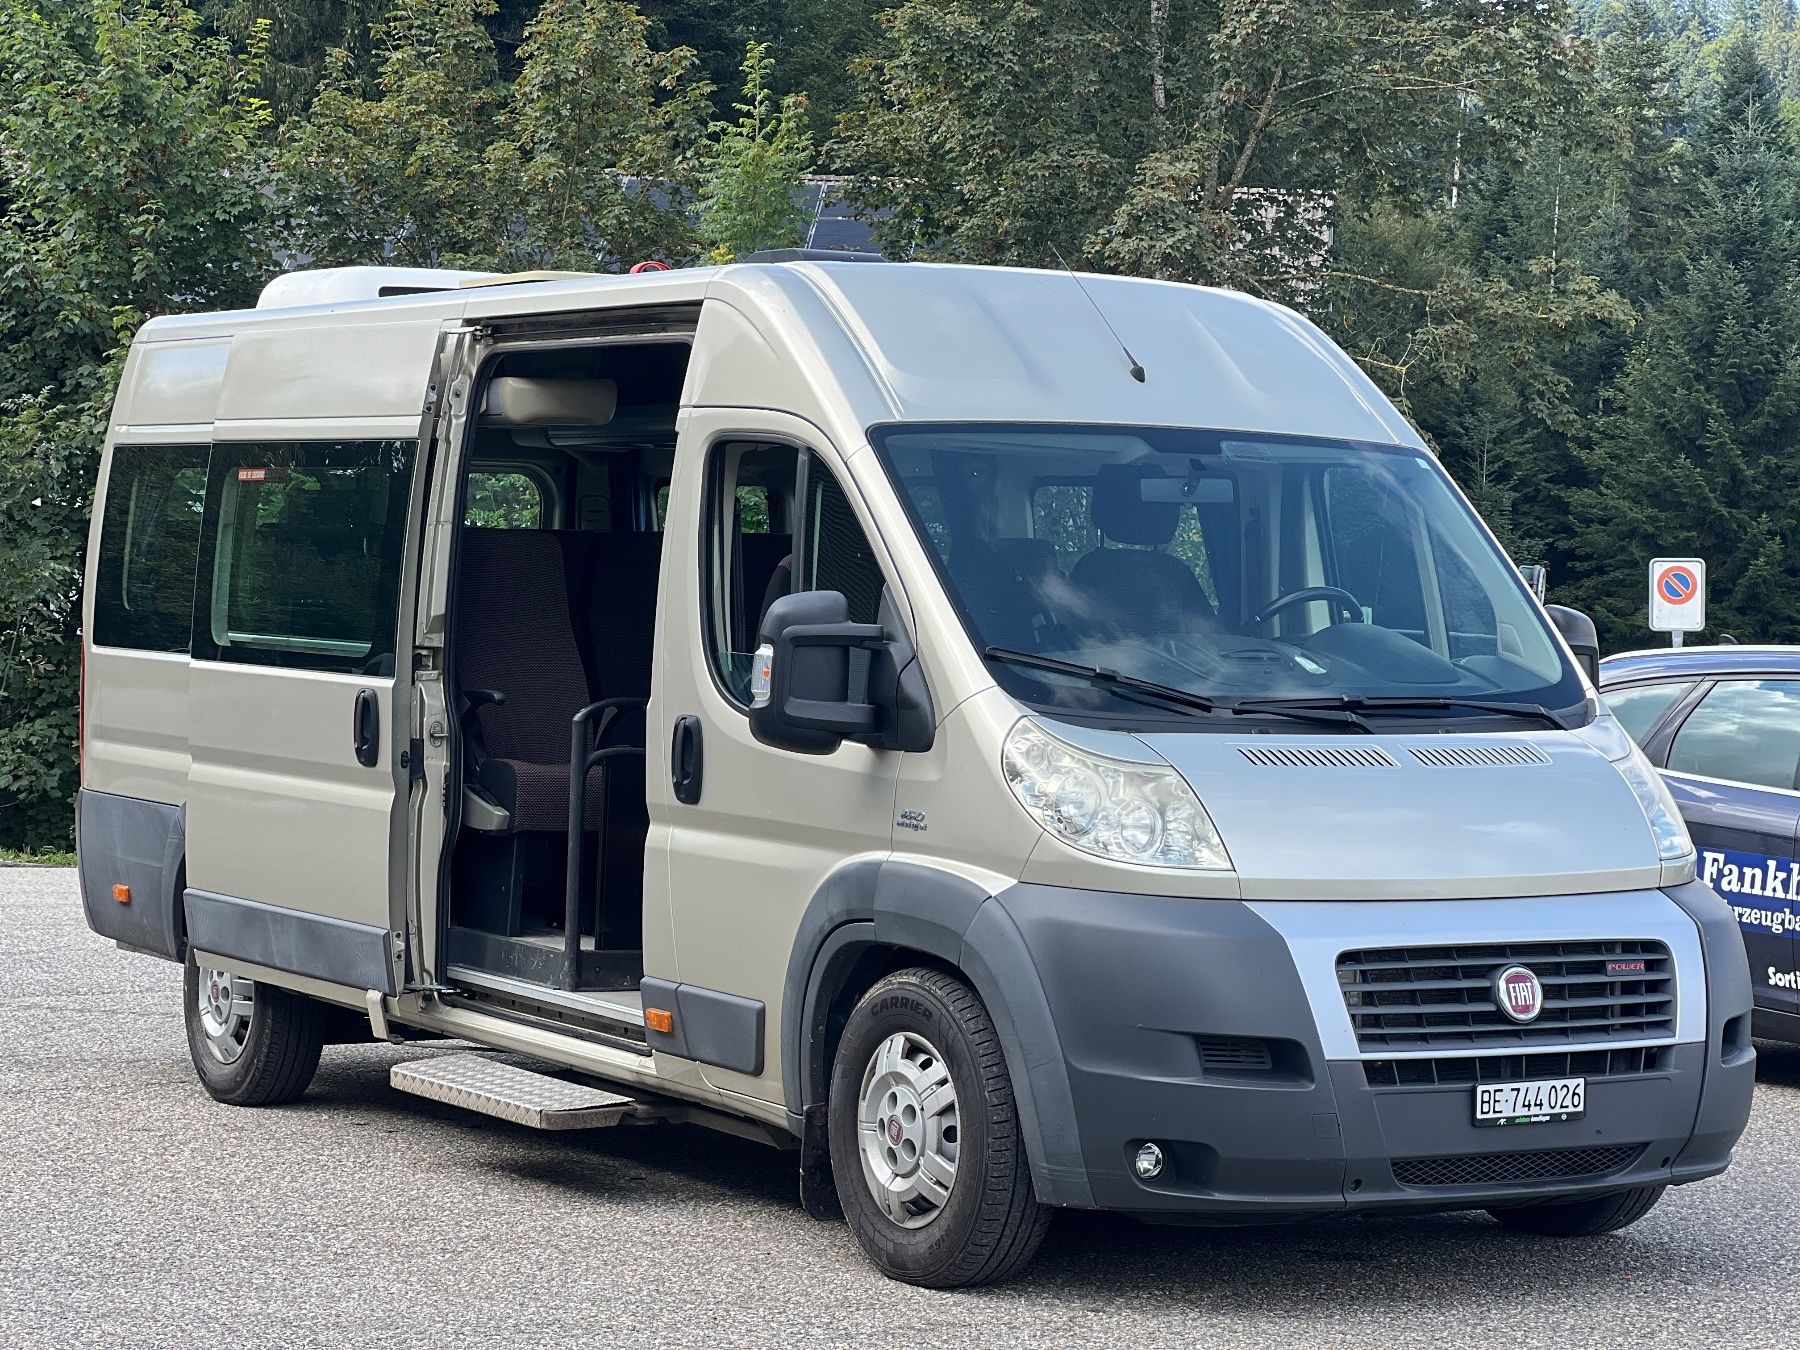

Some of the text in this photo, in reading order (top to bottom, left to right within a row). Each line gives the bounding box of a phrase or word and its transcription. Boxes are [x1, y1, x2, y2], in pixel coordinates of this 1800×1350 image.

[1723, 900, 1800, 934] rzeugb
[1608, 963, 1644, 971] POWER
[1509, 982, 1533, 1006] FIAT
[871, 996, 933, 1021] CARRIER
